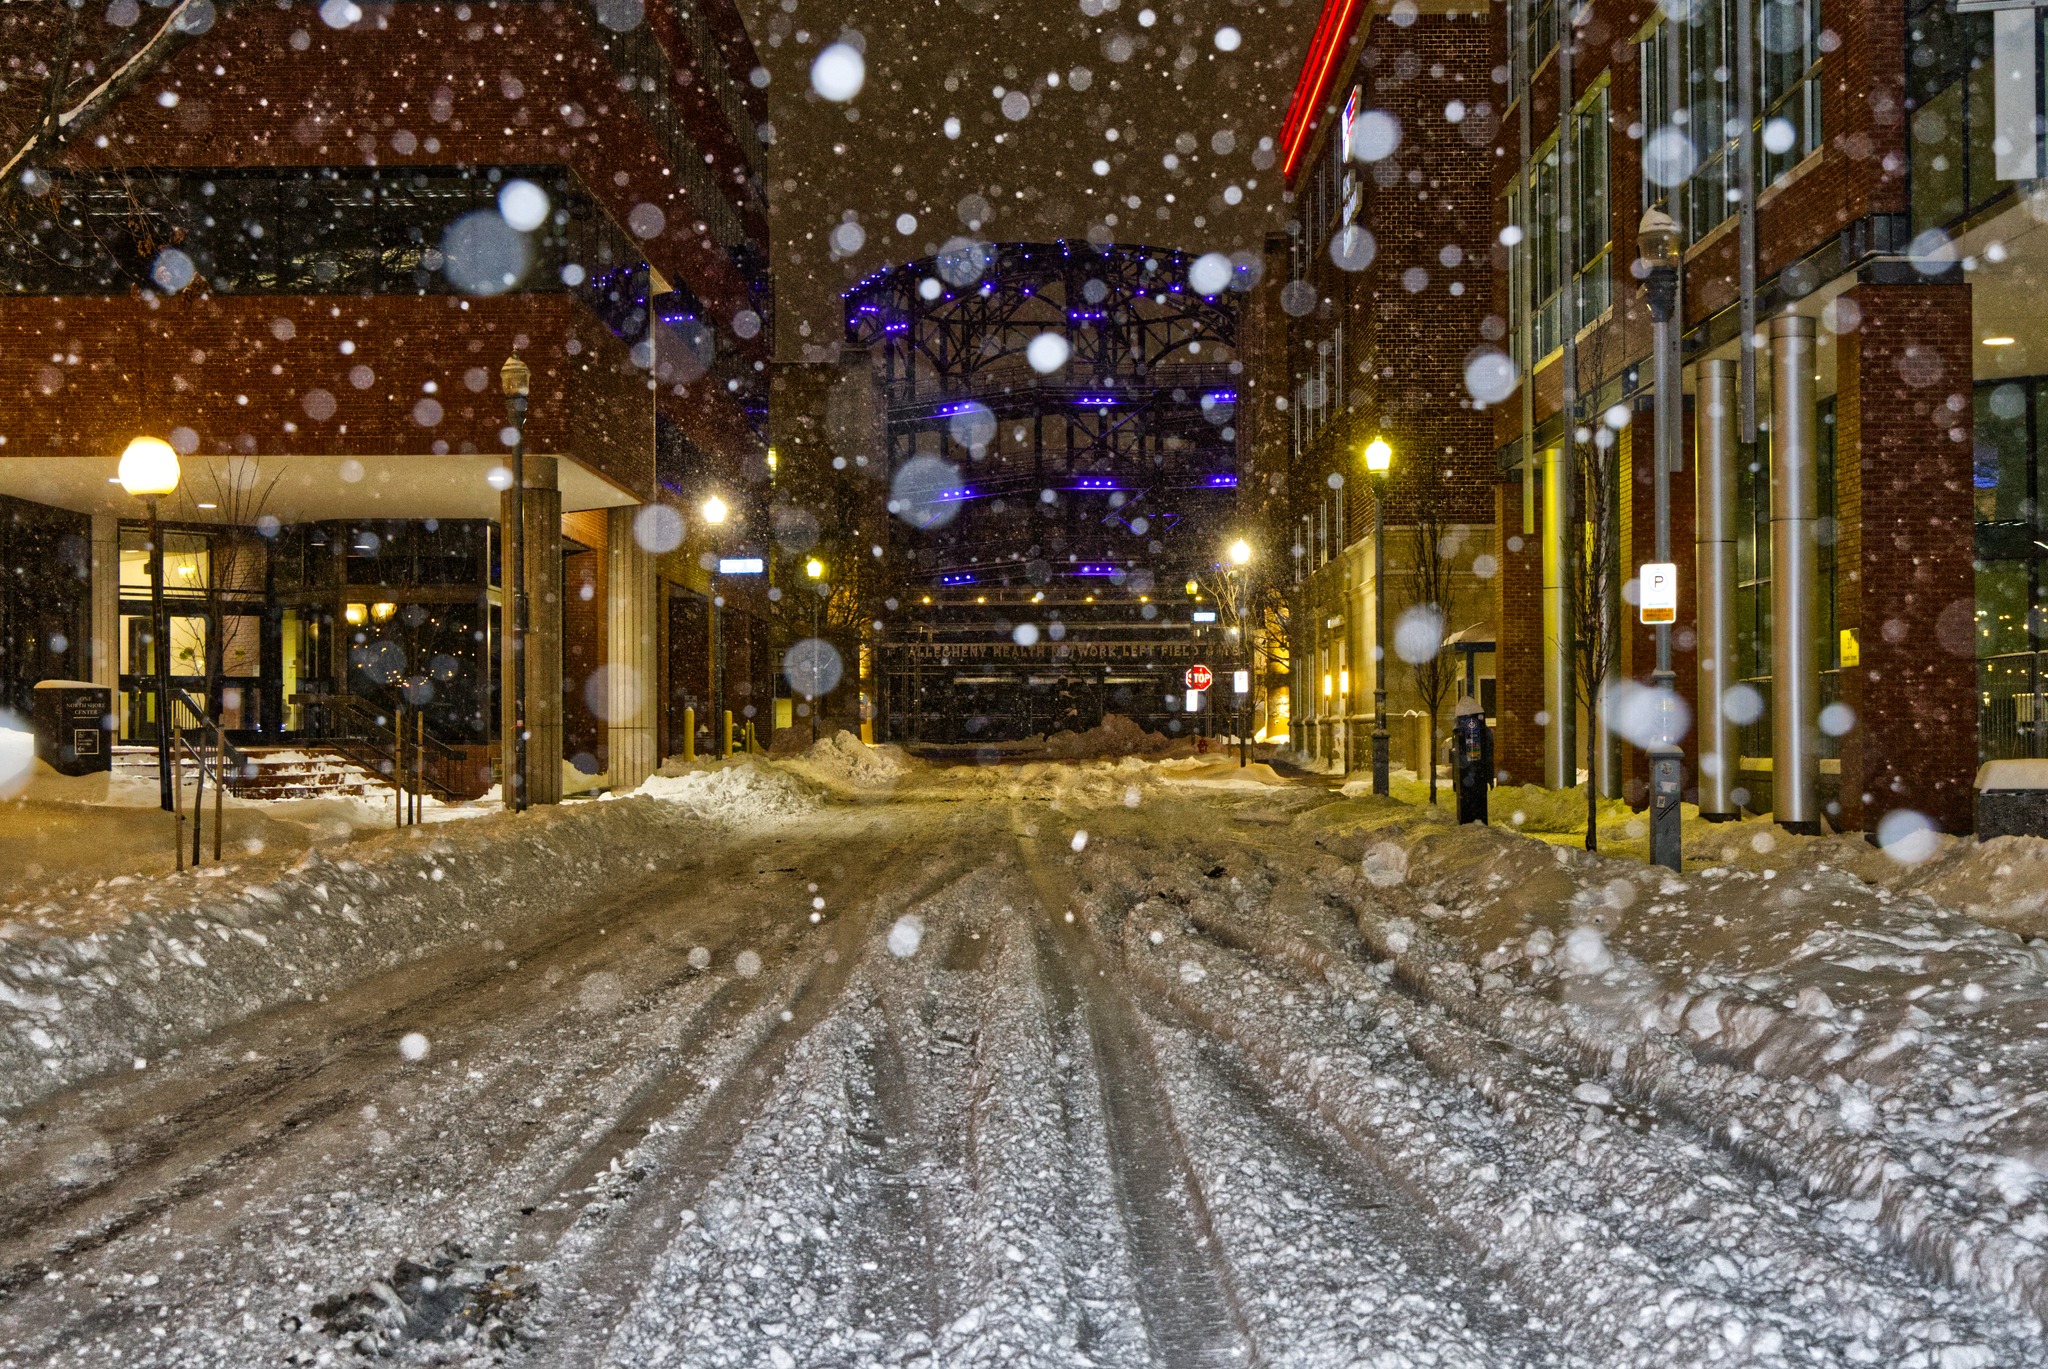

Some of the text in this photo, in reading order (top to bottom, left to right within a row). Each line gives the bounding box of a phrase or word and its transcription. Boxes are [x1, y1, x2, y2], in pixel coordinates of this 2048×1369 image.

[1654, 575, 1664, 588] P
[908, 645, 987, 657] ALLEGHENY
[993, 645, 1045, 657] HEALTH
[1051, 645, 1116, 657] NETWORK
[1123, 645, 1153, 656] LEFT
[1161, 645, 1199, 656] FIELD
[1188, 673, 1211, 684] STOP
